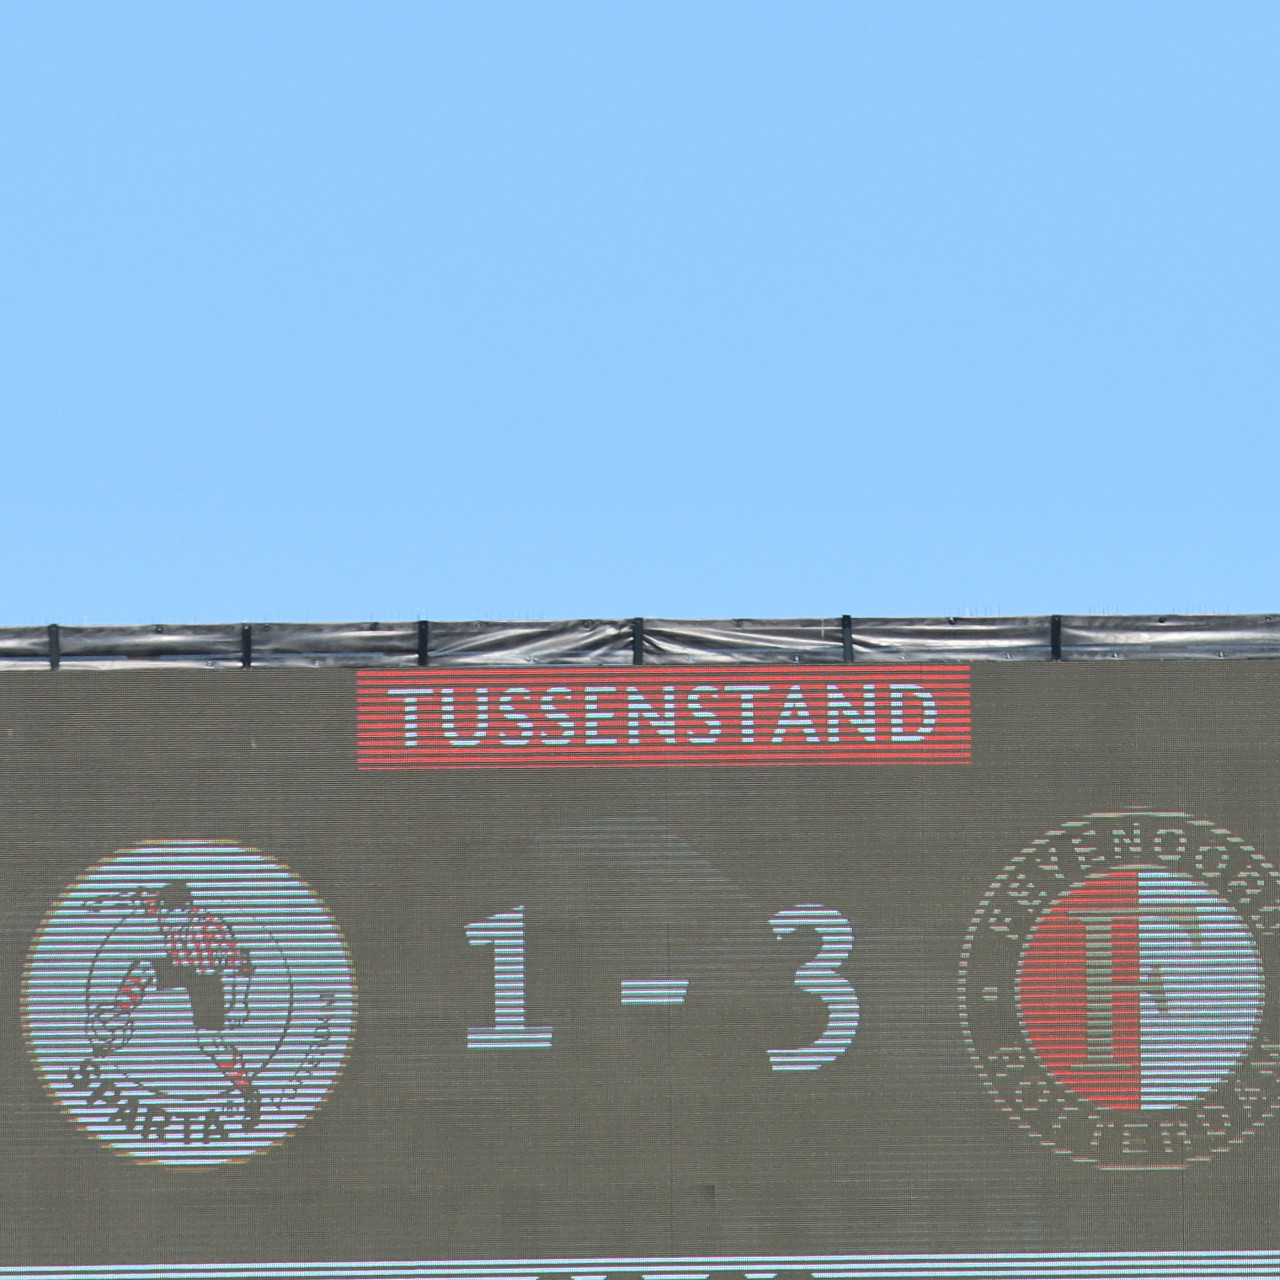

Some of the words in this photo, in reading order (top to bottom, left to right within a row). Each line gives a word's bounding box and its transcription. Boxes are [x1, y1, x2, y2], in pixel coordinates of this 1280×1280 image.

[387, 684, 939, 747] TUSSENSTAND
[464, 905, 553, 1048] 1
[767, 903, 860, 1071] 3
